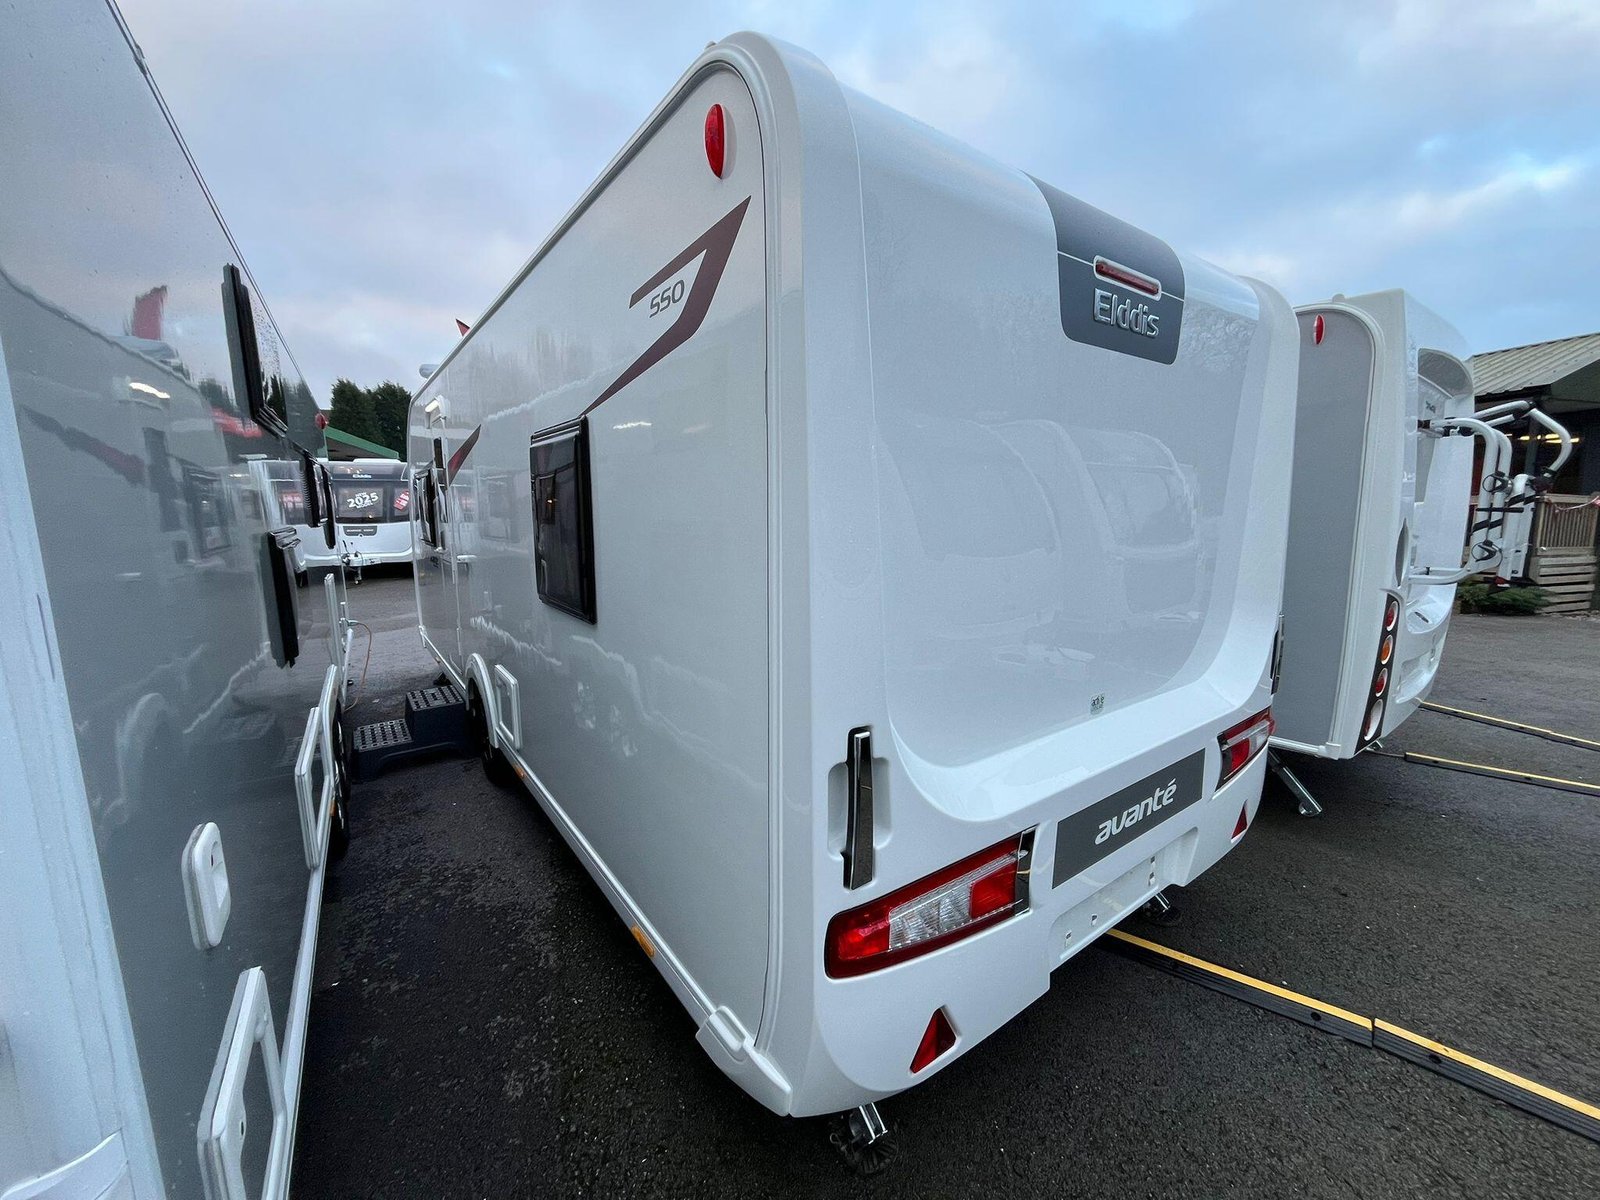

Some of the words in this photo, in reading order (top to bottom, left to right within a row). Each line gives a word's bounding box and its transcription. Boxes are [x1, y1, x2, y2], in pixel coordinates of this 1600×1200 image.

[648, 279, 685, 319] 550
[1093, 287, 1160, 338] Elddis
[347, 492, 378, 507] 2025
[1094, 777, 1177, 845] avanté
